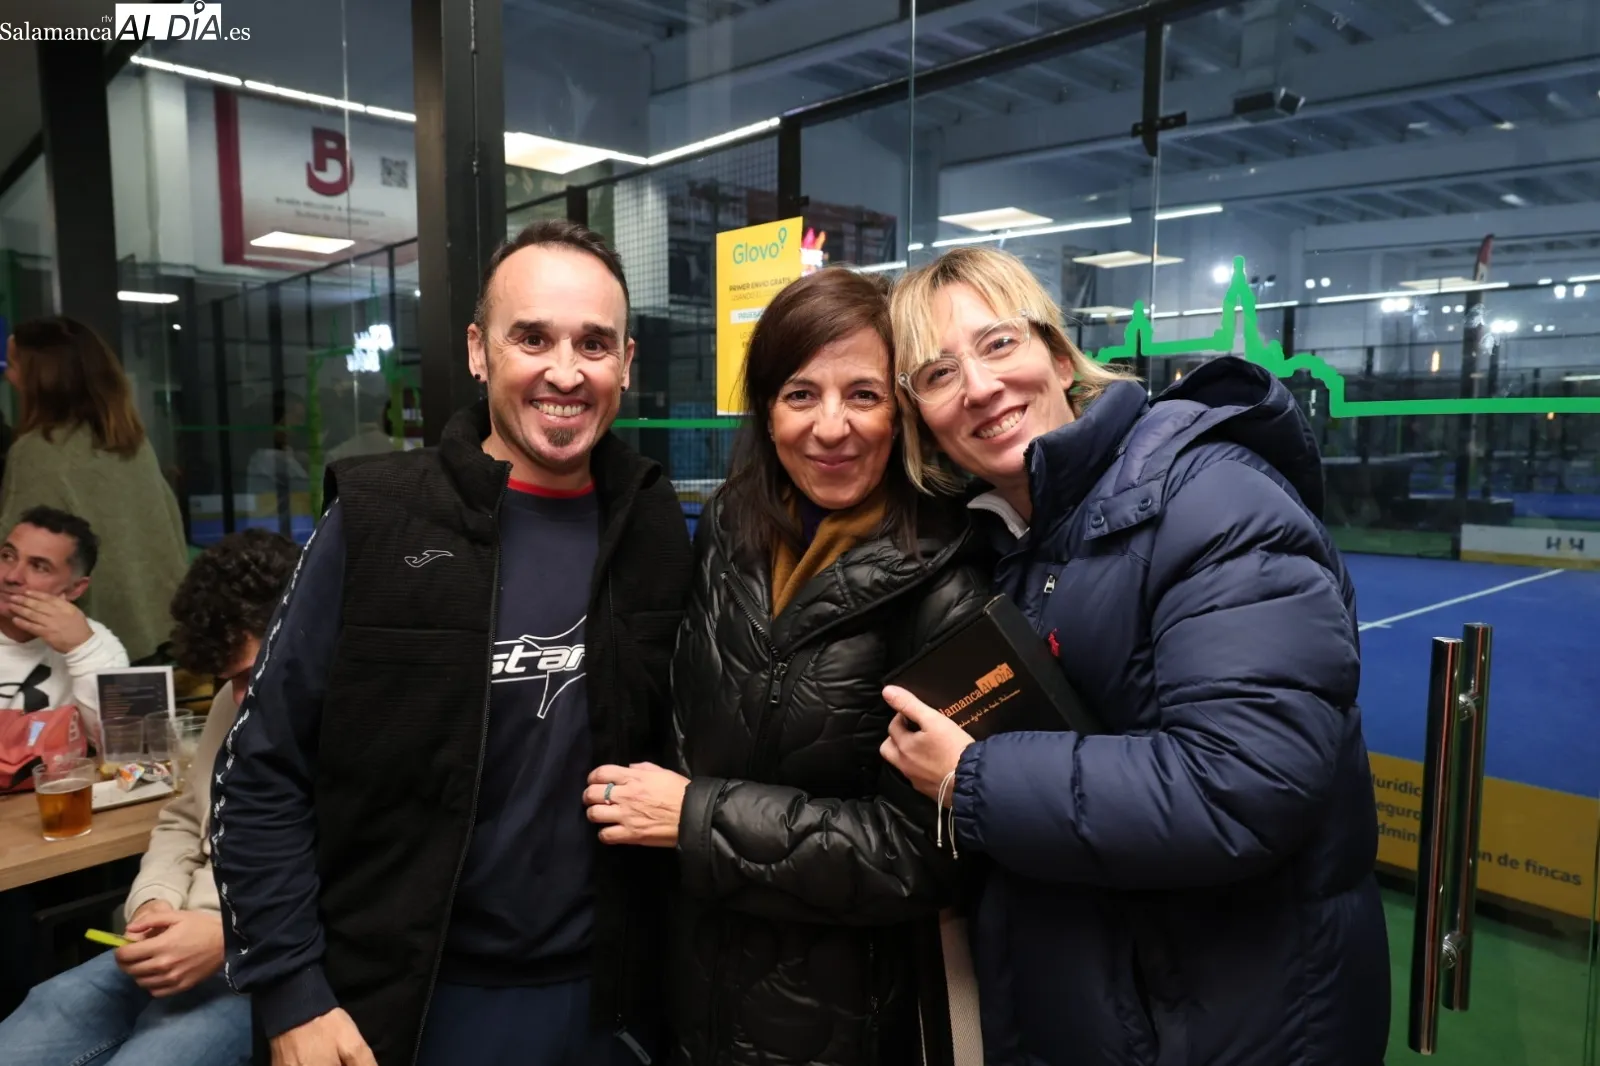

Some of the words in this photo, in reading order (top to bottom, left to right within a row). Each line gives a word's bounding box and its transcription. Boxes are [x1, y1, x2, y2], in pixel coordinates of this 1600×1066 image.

[733, 241, 780, 265] Glovo
[938, 688, 984, 717] lamanca
[1497, 851, 1520, 870] de
[1524, 858, 1582, 886] fincas
